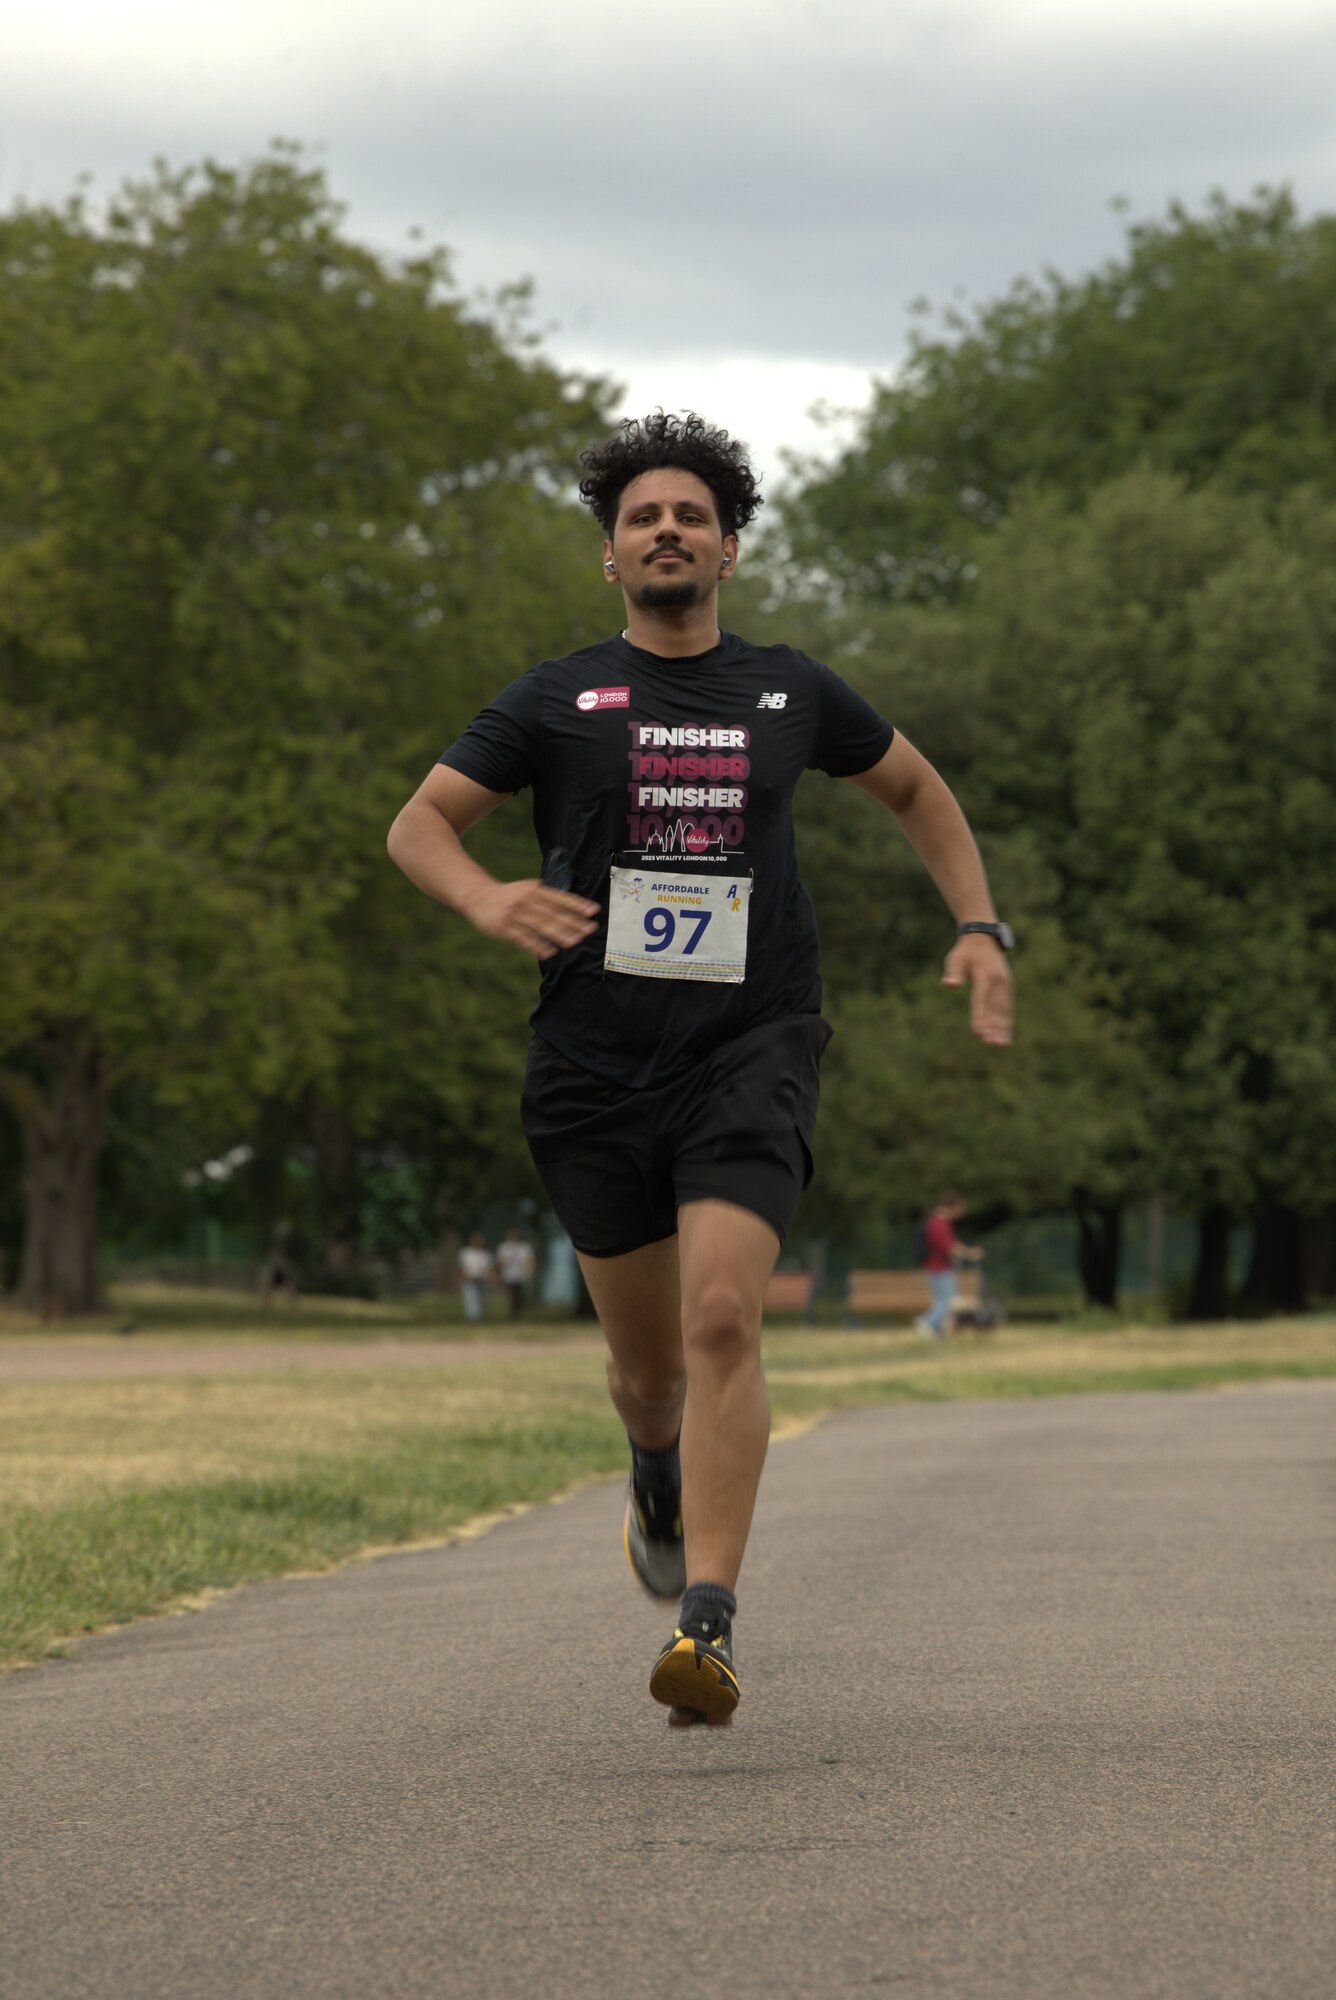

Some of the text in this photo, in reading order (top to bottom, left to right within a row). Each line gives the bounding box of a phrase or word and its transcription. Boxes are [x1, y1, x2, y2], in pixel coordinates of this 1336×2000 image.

[756, 692, 788, 709] NB
[639, 727, 746, 748] FINISHER
[639, 756, 746, 777] FINISHER
[638, 787, 744, 808] FINISHER
[686, 834, 709, 846] Vitality
[651, 883, 710, 895] AFFORDABLE
[727, 885, 737, 898] A
[657, 895, 702, 905] RUNNING
[731, 898, 741, 912] R
[643, 907, 712, 955] 97
